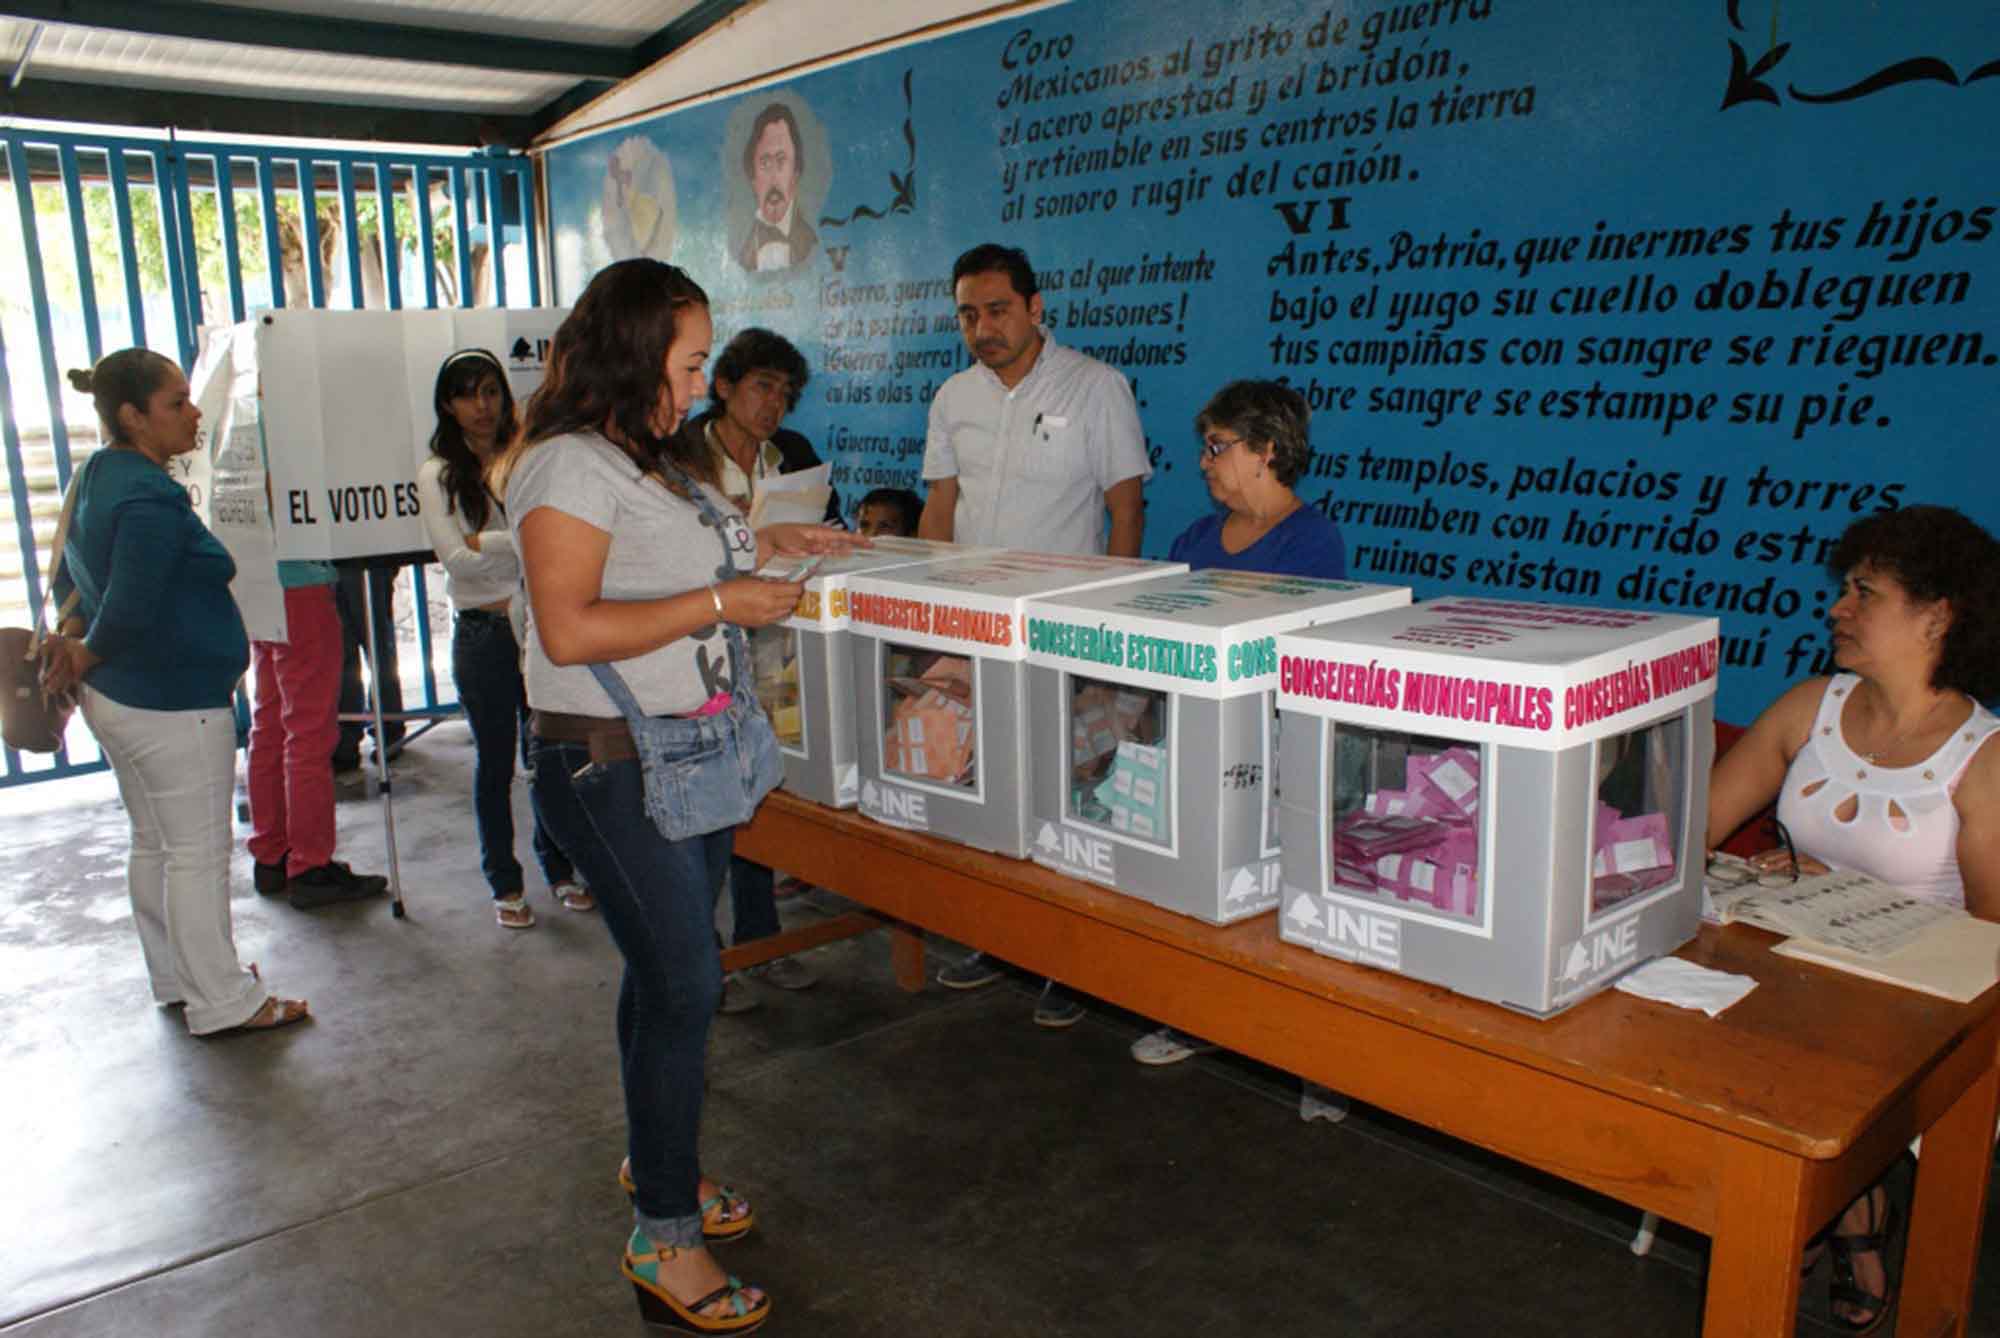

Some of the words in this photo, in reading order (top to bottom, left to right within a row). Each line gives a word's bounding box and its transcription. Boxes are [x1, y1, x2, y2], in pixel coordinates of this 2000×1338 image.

[1001, 28, 1074, 70] Coro
[1163, 36, 1194, 78] al
[1203, 22, 1294, 78] grito
[1307, 10, 1348, 49] de
[1360, 0, 1492, 51] guerra
[1000, 117, 1019, 147] el
[1027, 111, 1092, 144] acero
[1101, 75, 1238, 135] aprestad
[1247, 79, 1268, 116] y
[1278, 63, 1307, 101] el
[1316, 36, 1470, 94] bridón,
[1003, 160, 1018, 194] y
[1024, 135, 1152, 182] retiemble
[1160, 135, 1191, 161] en
[1200, 126, 1248, 156] sus
[1260, 107, 1378, 148] centros
[1386, 95, 1420, 133] la
[1429, 83, 1536, 125] tierra
[1001, 194, 1025, 223] al
[1034, 188, 1117, 219] sonoro
[1131, 167, 1213, 215] rugir
[1226, 159, 1281, 198] del
[1293, 143, 1420, 190] cañón.
[1267, 239, 1380, 277] Antes,
[1386, 228, 1508, 272] Patria,
[1514, 235, 1581, 278] que
[1586, 220, 1755, 262] inermes
[1769, 208, 1848, 255] tus
[1855, 196, 1999, 263] hijos
[1273, 197, 1352, 235] VI
[1069, 257, 1095, 289] al
[1097, 264, 1136, 295] que
[1139, 248, 1217, 284] intente
[1269, 286, 1338, 330] bajo
[1350, 285, 1380, 319] el
[1386, 288, 1480, 332] yugo
[1491, 286, 1539, 317] su
[1550, 273, 1678, 314] cuello
[1694, 265, 1972, 322] dobleguen
[1269, 334, 1320, 365] tus
[1327, 329, 1489, 376] campiñas
[1500, 337, 1564, 366] con
[1576, 334, 1713, 378] sangre
[1727, 333, 1775, 366] se
[1786, 323, 1999, 379] rieguen.
[847, 377, 872, 403] las
[877, 379, 914, 404] olas
[1368, 383, 1483, 428] sangre
[1492, 387, 1534, 418] se
[1538, 380, 1719, 437] estampe
[1727, 392, 1785, 425] su
[1792, 382, 1892, 440] pie.
[289, 488, 317, 525] EL
[328, 484, 388, 524] VOTO
[395, 481, 421, 518] ES
[1302, 445, 1350, 481] tus
[1357, 447, 1499, 495] templos,
[1507, 456, 1683, 501] palacios
[1692, 474, 1728, 516] y
[1746, 465, 1908, 513] torres
[1490, 511, 1549, 542] con
[1562, 508, 1720, 556] hórrido
[1733, 523, 1842, 566] estr
[1353, 540, 1458, 582] ruinas
[1466, 550, 1602, 598] existan
[933, 603, 1013, 647] NACIONALES
[1028, 622, 1124, 668] CONSEJERÍAS
[1126, 633, 1219, 683] ESTATALES
[1279, 658, 1401, 711] CONSEJERÍAS
[1402, 670, 1553, 731] MUNICIPALES
[1564, 660, 1650, 730] CONSEJERÍAS
[1651, 637, 1718, 701] MUNICIPALES
[881, 785, 928, 823] INE
[1063, 830, 1114, 874] INE
[1327, 903, 1399, 957] INE
[1592, 912, 1640, 971] INE
